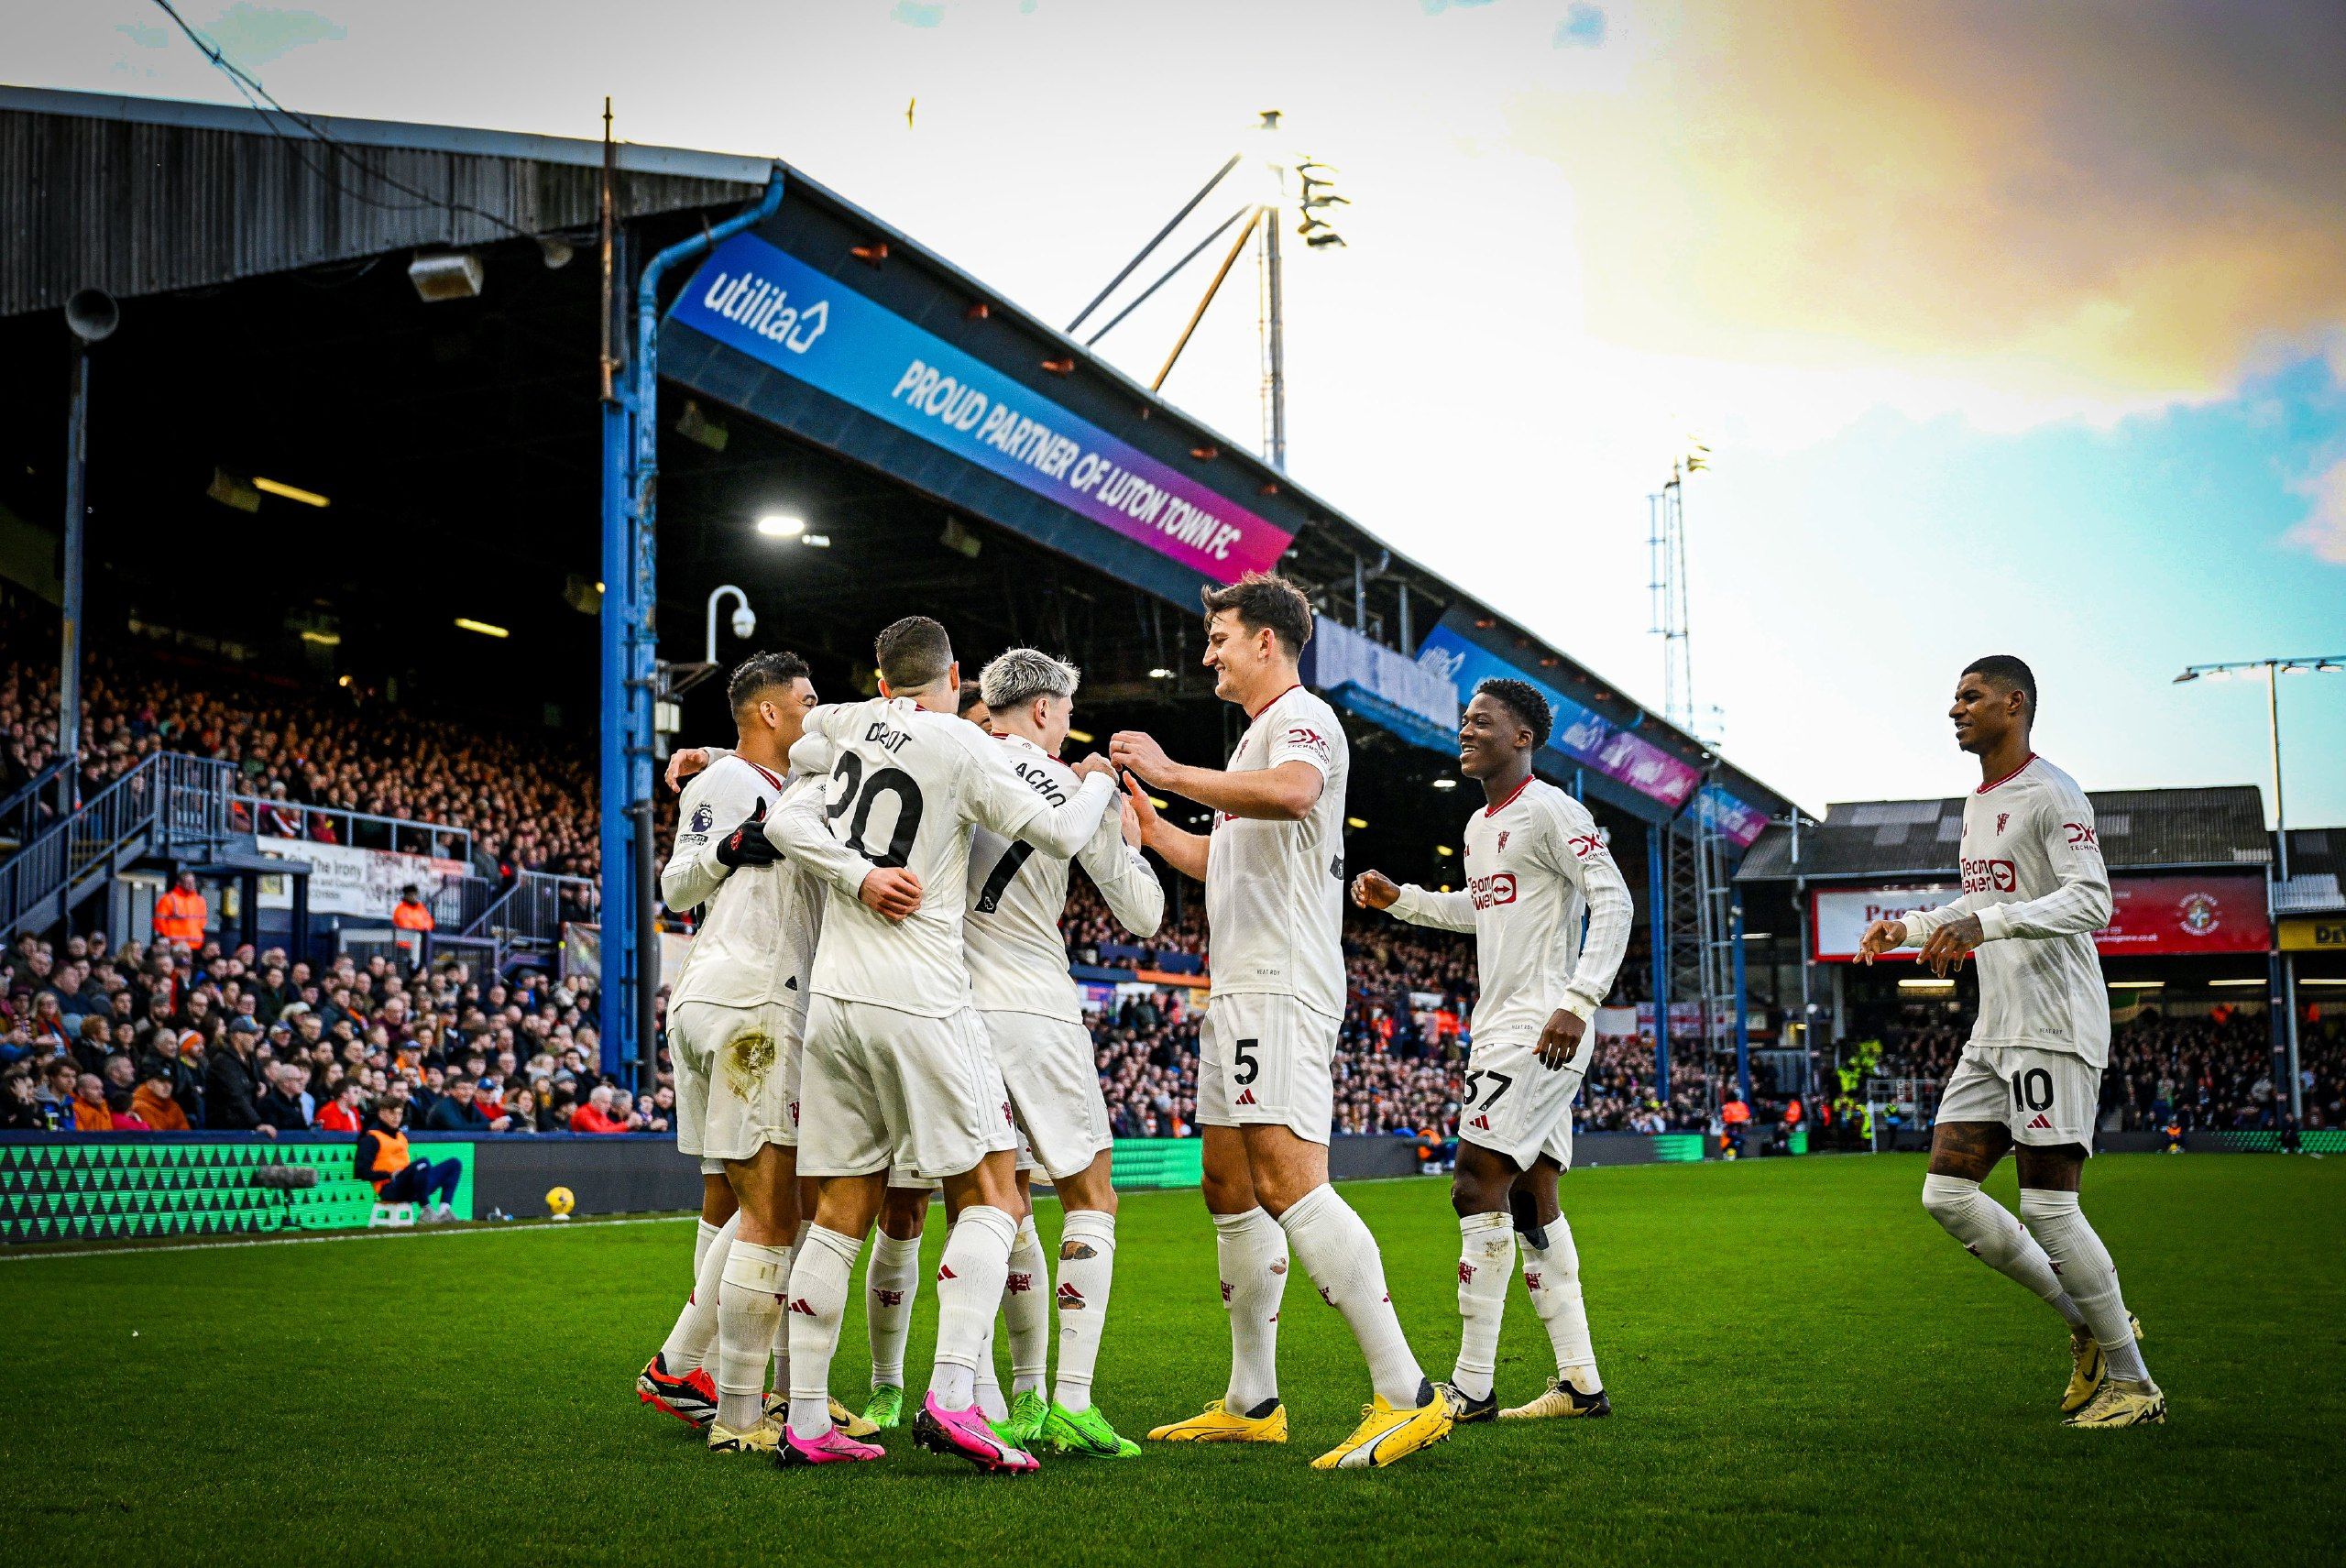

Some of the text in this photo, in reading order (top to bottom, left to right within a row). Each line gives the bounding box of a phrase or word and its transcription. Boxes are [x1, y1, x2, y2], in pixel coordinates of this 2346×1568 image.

[704, 272, 798, 344] utilita
[891, 359, 1242, 561] PROUD PARTNER OF LUTON TOWN FC
[826, 750, 924, 868] 20
[1467, 876, 1492, 894] Team
[1960, 858, 1990, 877] Team
[1233, 1038, 1259, 1086] 5
[1464, 1069, 1513, 1112] 37
[2011, 1068, 2055, 1113] 10
